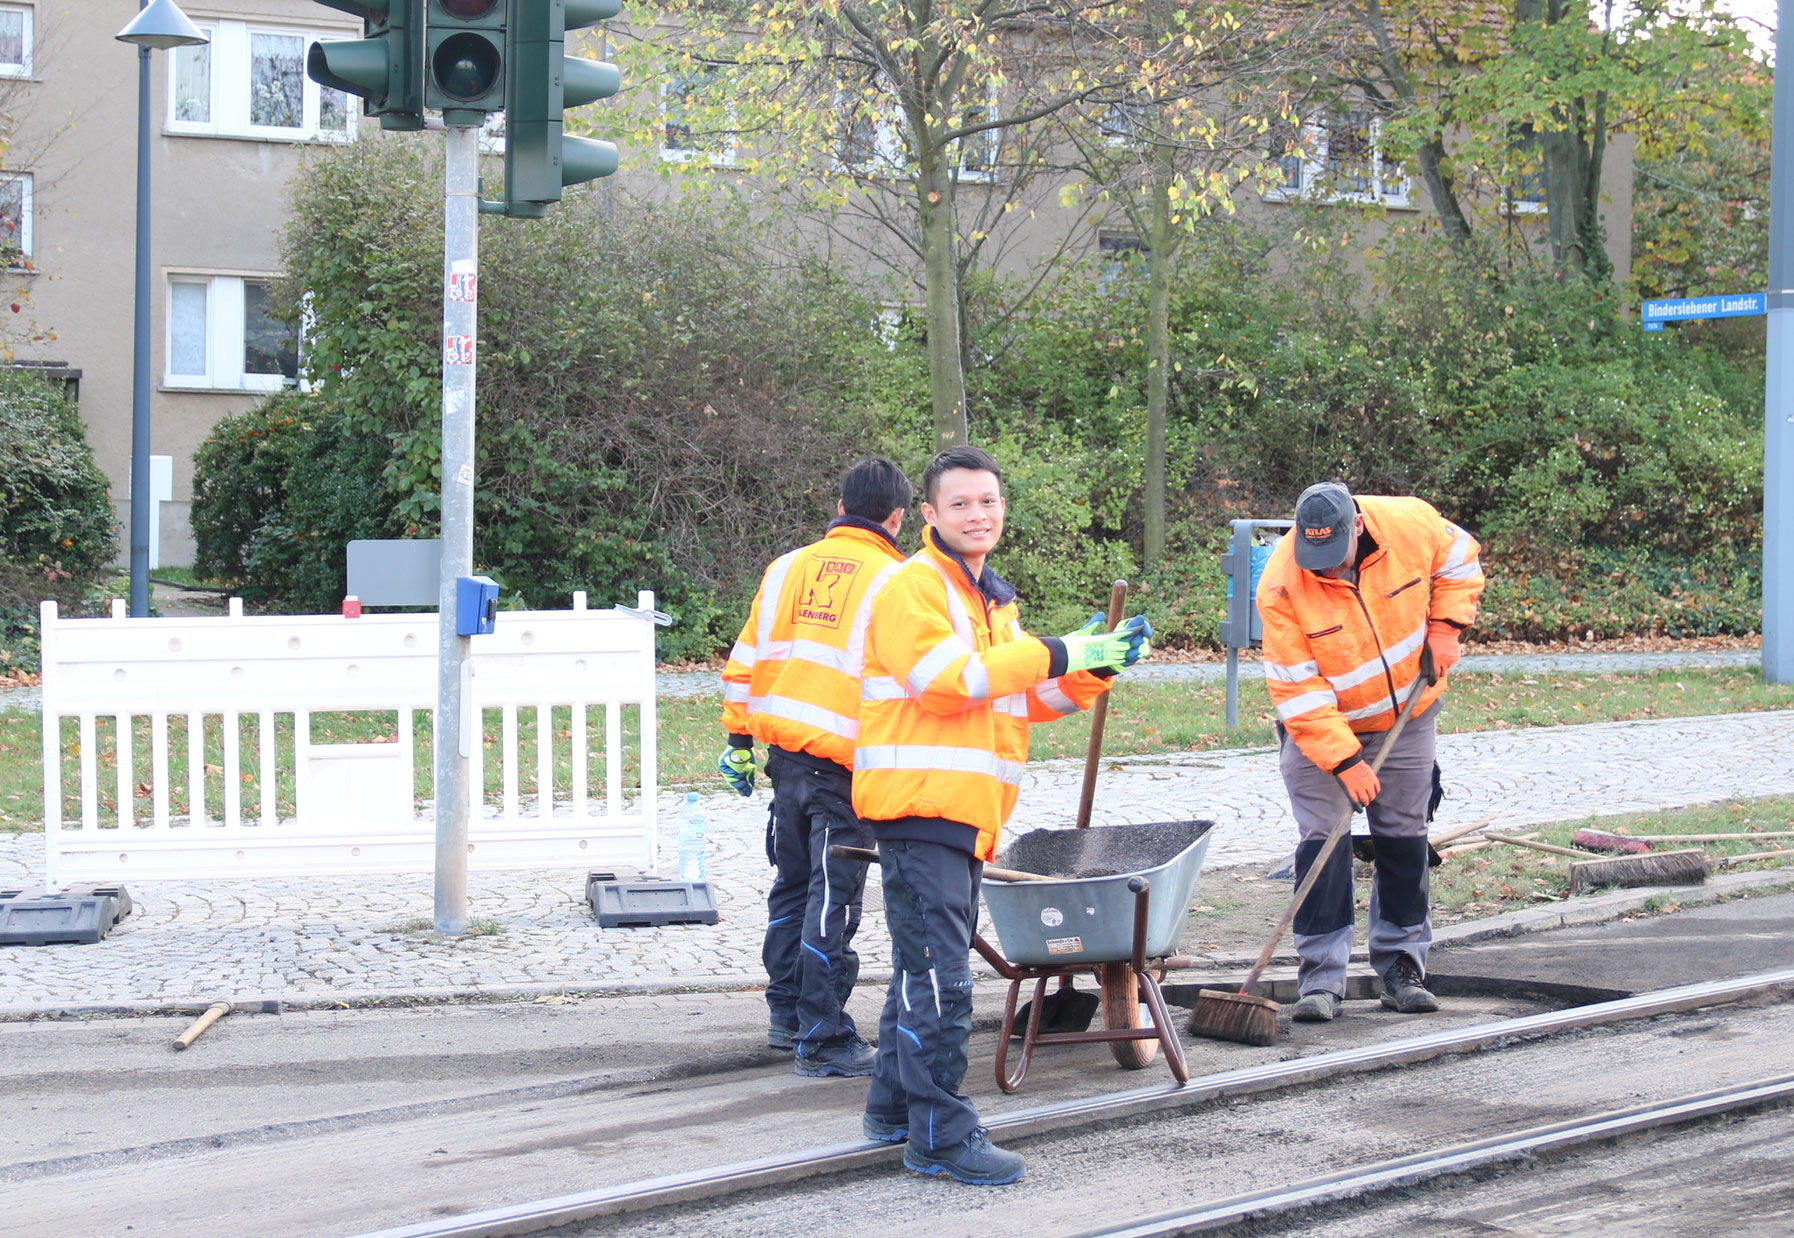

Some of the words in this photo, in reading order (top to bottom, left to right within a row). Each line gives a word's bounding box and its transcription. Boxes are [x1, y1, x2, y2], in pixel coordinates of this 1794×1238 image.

[1648, 301, 1717, 317] Binderslebener
[1721, 297, 1759, 312] Landstr.
[1305, 526, 1332, 536] ATLAS
[827, 561, 855, 574] BAU
